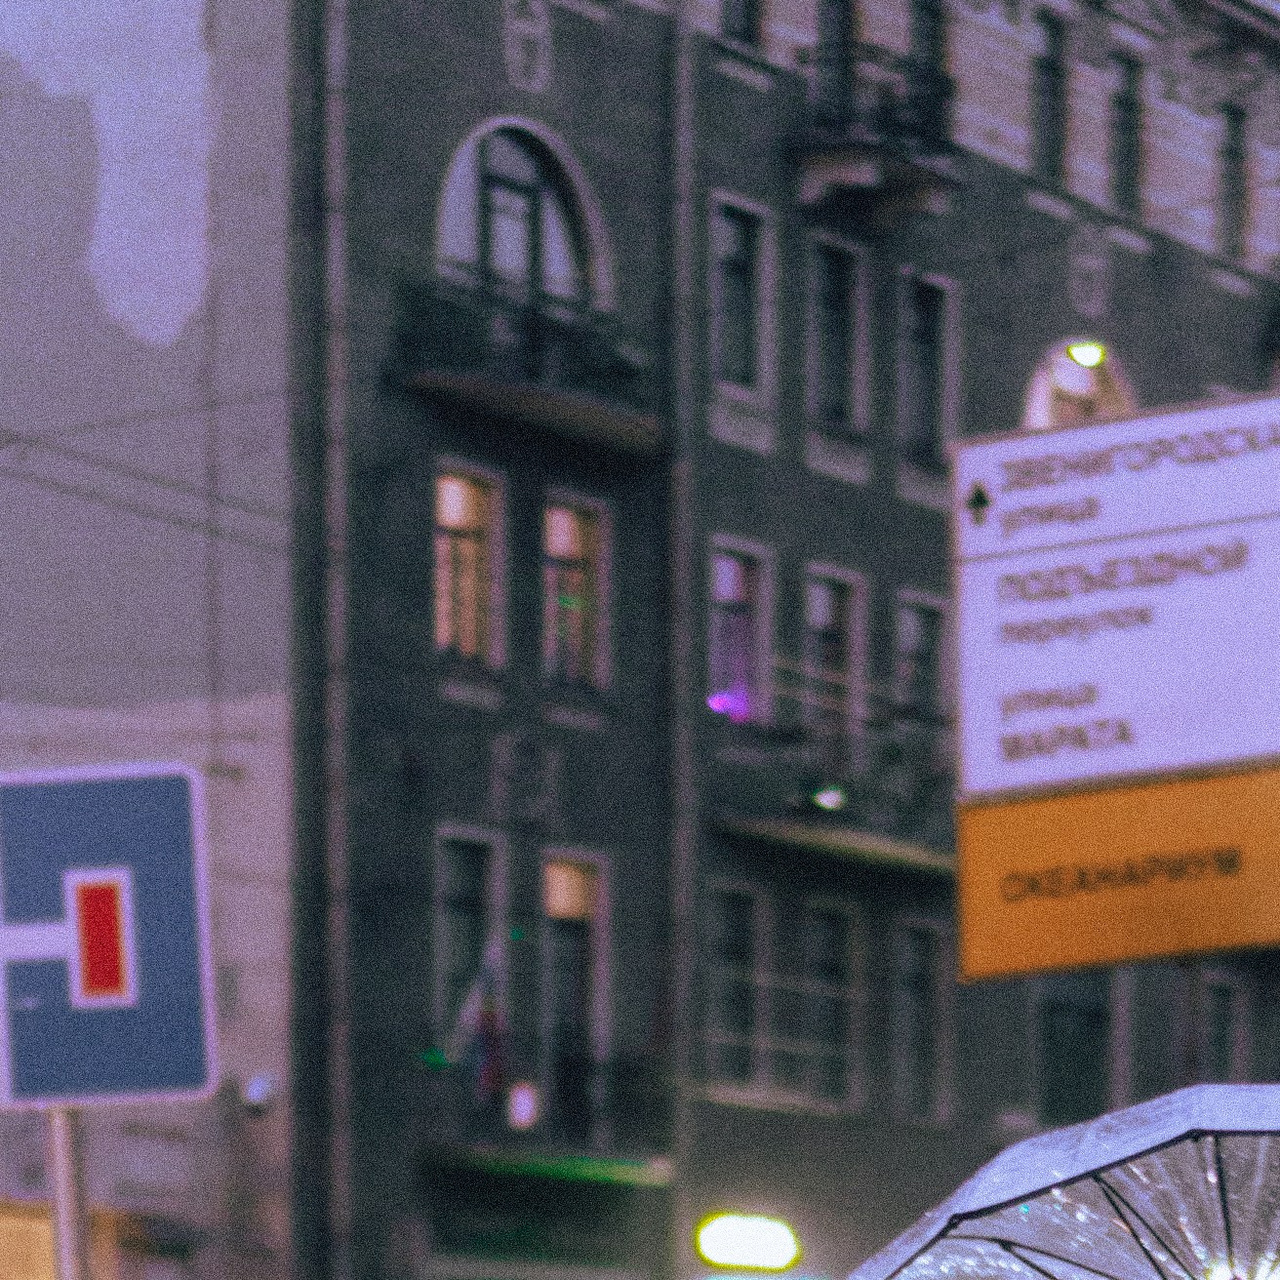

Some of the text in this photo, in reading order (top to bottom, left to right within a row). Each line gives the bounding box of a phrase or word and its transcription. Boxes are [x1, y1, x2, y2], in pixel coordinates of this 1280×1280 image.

[1001, 541, 1249, 601] ПОДЪЕЗДНОЙ
[1001, 720, 1133, 762] МАРАТА
[1002, 847, 1243, 902] ОКЕАНАРИУМ
